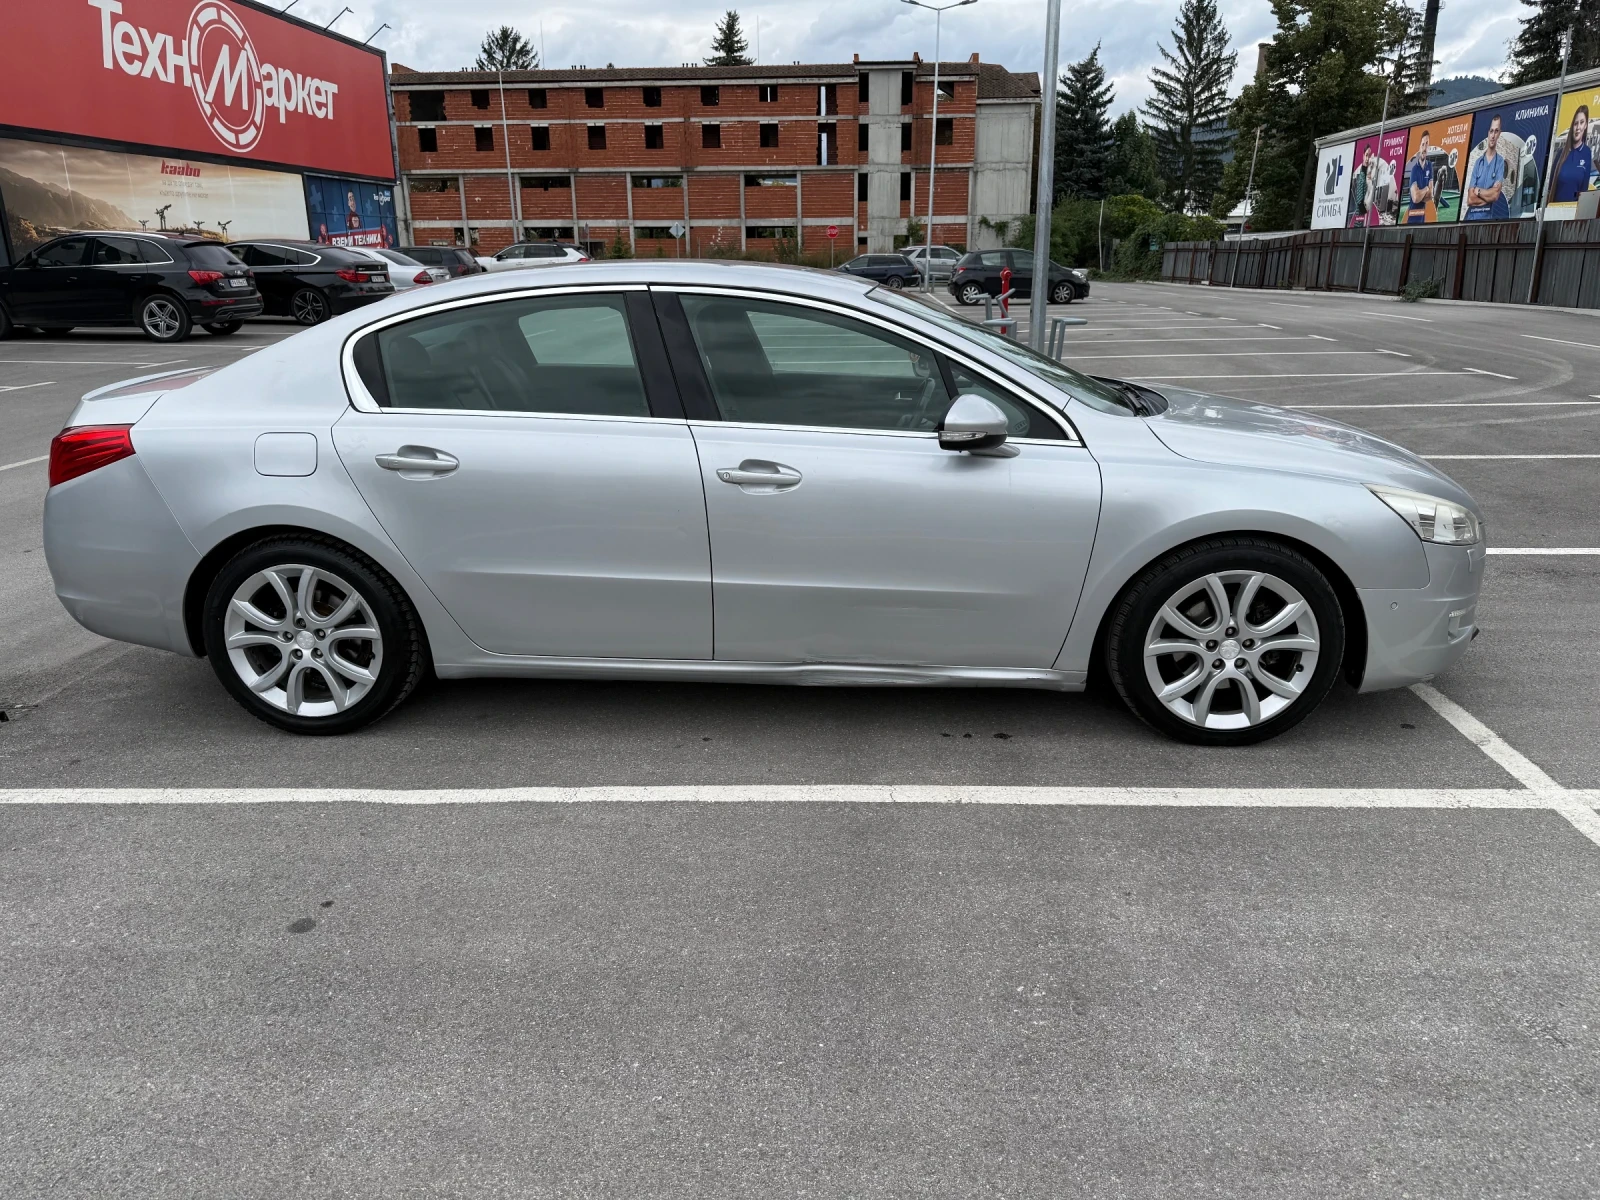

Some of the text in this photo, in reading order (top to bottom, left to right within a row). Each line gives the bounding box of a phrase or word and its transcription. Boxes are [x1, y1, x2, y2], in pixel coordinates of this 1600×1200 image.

[1515, 105, 1549, 120] КЛИНИКА
[160, 159, 201, 178] kaabo
[1316, 203, 1342, 219] СИМБА
